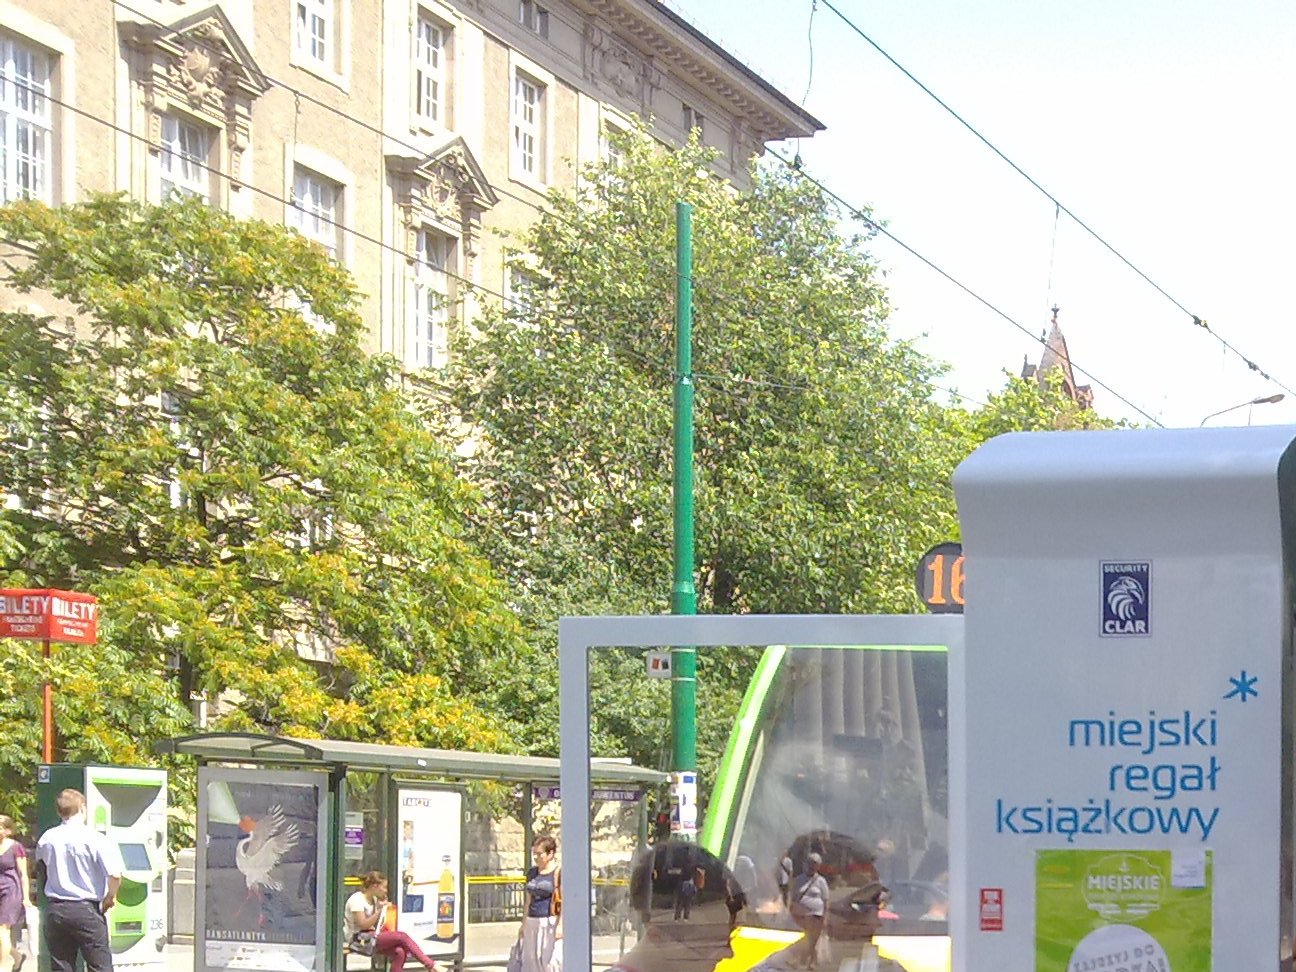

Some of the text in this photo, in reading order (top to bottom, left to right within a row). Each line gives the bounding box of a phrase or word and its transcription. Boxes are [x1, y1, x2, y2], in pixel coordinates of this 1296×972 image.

[1104, 564, 1148, 573] SECURITY
[0, 595, 50, 614] BILETY
[51, 596, 96, 620] BILETY
[1104, 620, 1147, 633] CLAR
[1068, 710, 1217, 755] miejski
[1109, 755, 1222, 800] regał
[996, 799, 1220, 843] książkowy
[1087, 875, 1160, 893] MIEJSKIE
